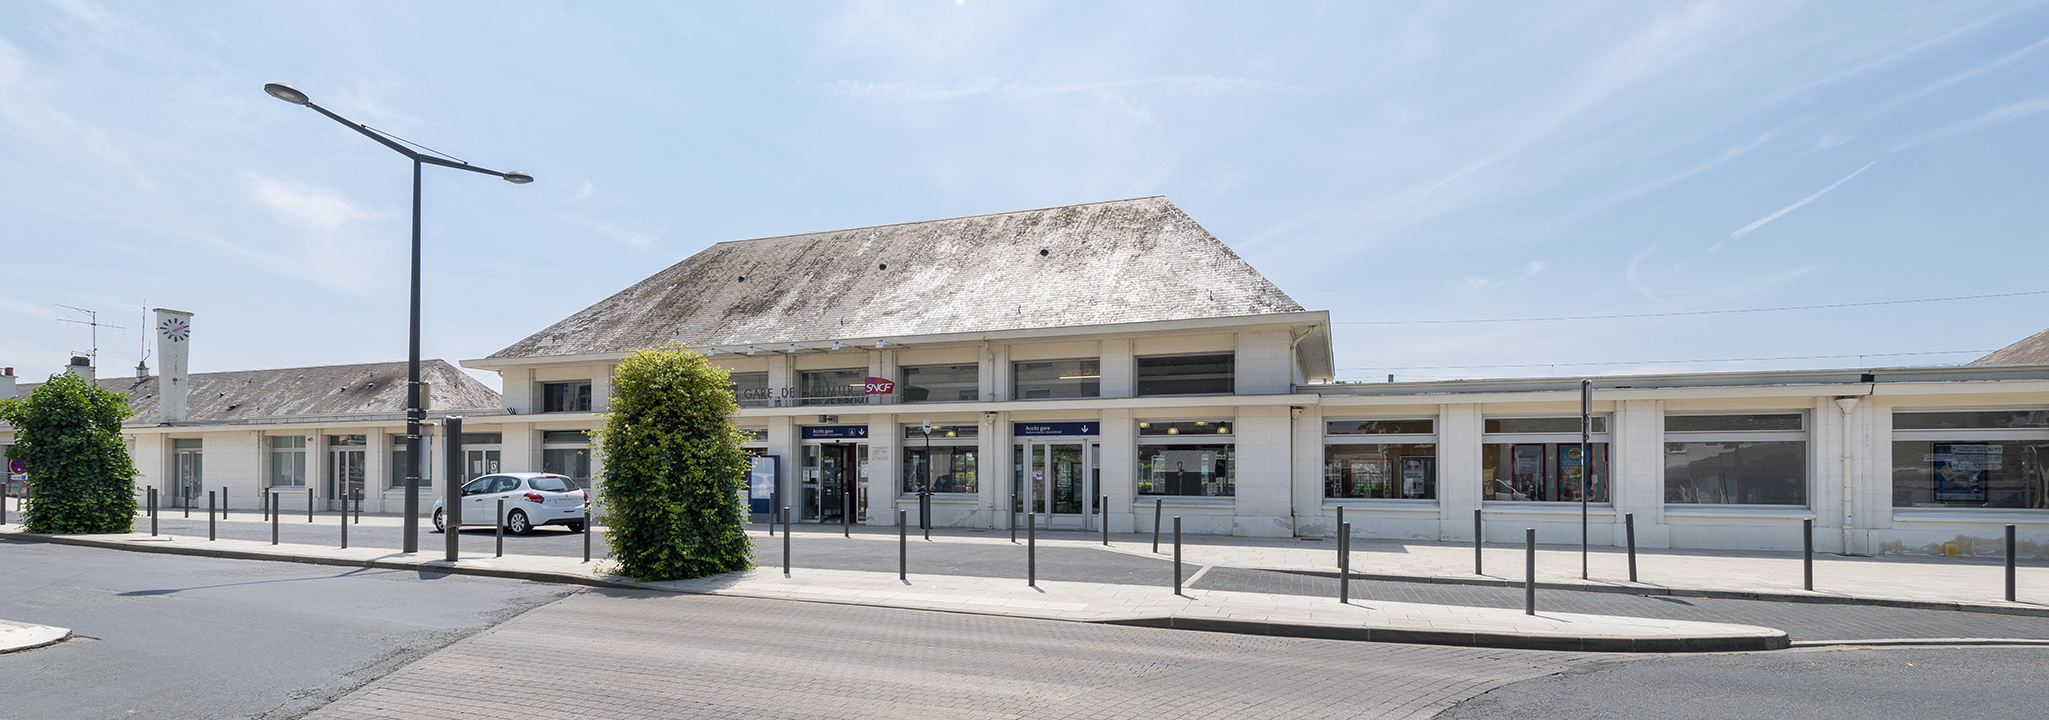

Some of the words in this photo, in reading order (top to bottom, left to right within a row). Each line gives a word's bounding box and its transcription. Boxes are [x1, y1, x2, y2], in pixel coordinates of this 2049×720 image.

[744, 388, 773, 399] GARE
[781, 387, 795, 398] DE
[802, 385, 854, 397] SAUMUR
[866, 382, 893, 393] SNCF
